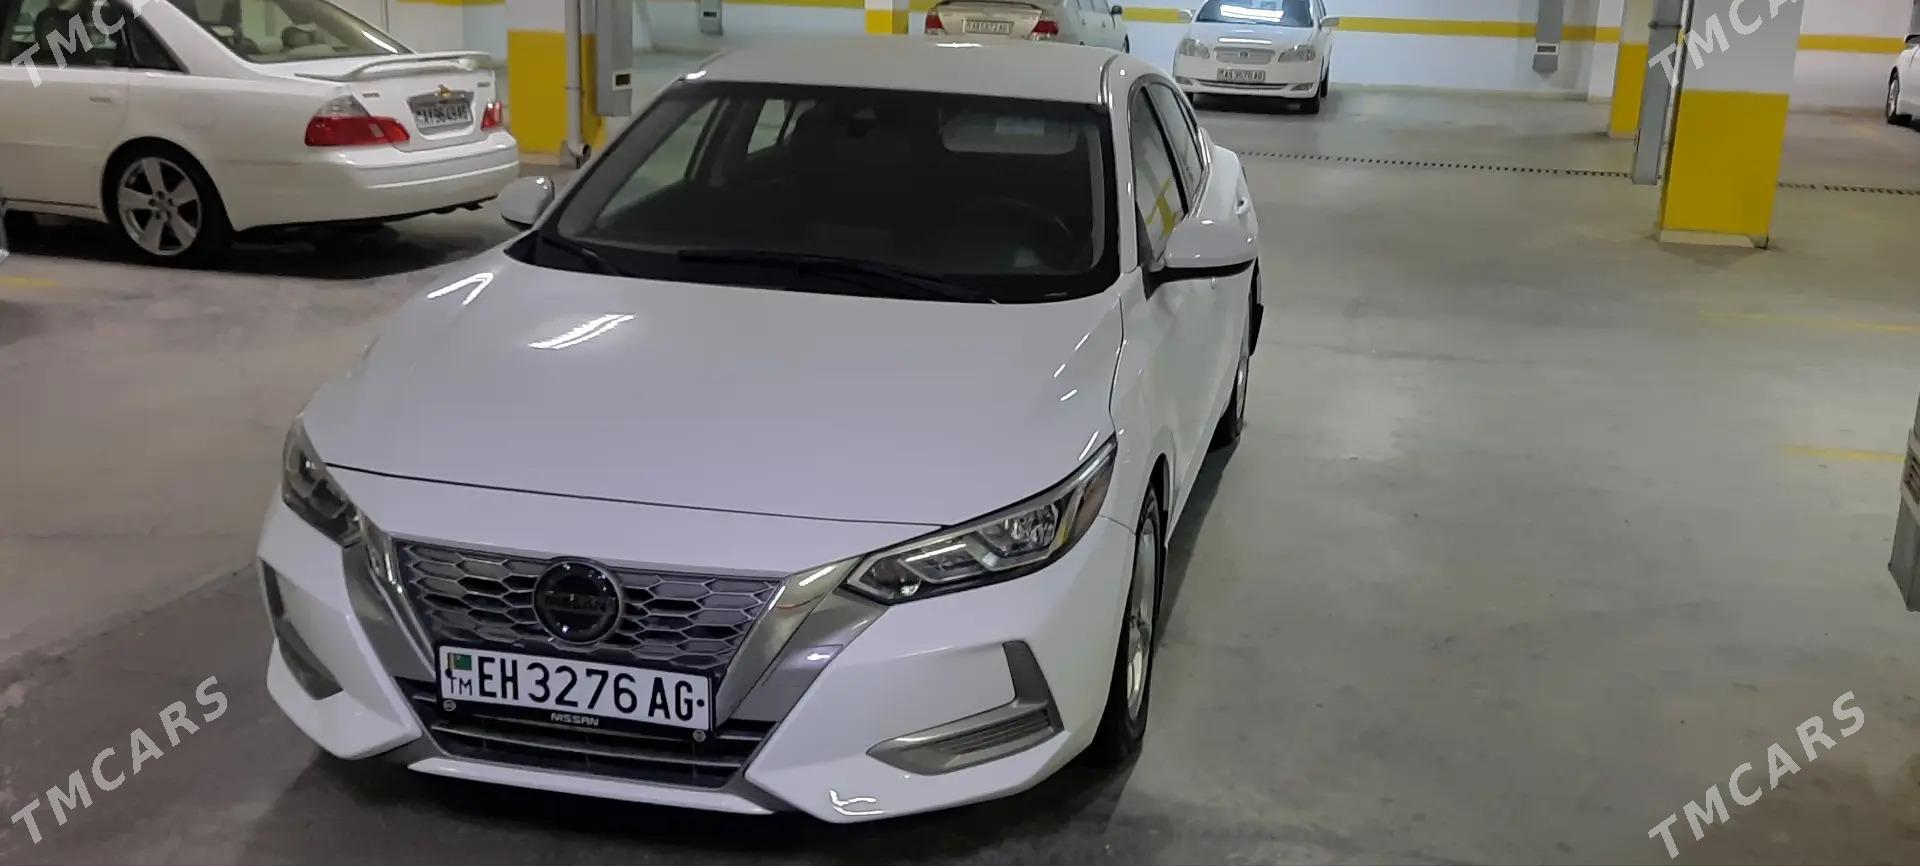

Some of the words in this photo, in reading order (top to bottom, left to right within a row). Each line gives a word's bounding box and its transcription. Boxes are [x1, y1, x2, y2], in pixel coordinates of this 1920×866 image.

[449, 676, 473, 697] TM
[477, 656, 519, 701] EH
[526, 662, 638, 714] 3276
[647, 676, 694, 722] AG
[550, 711, 600, 727] NISSAN
